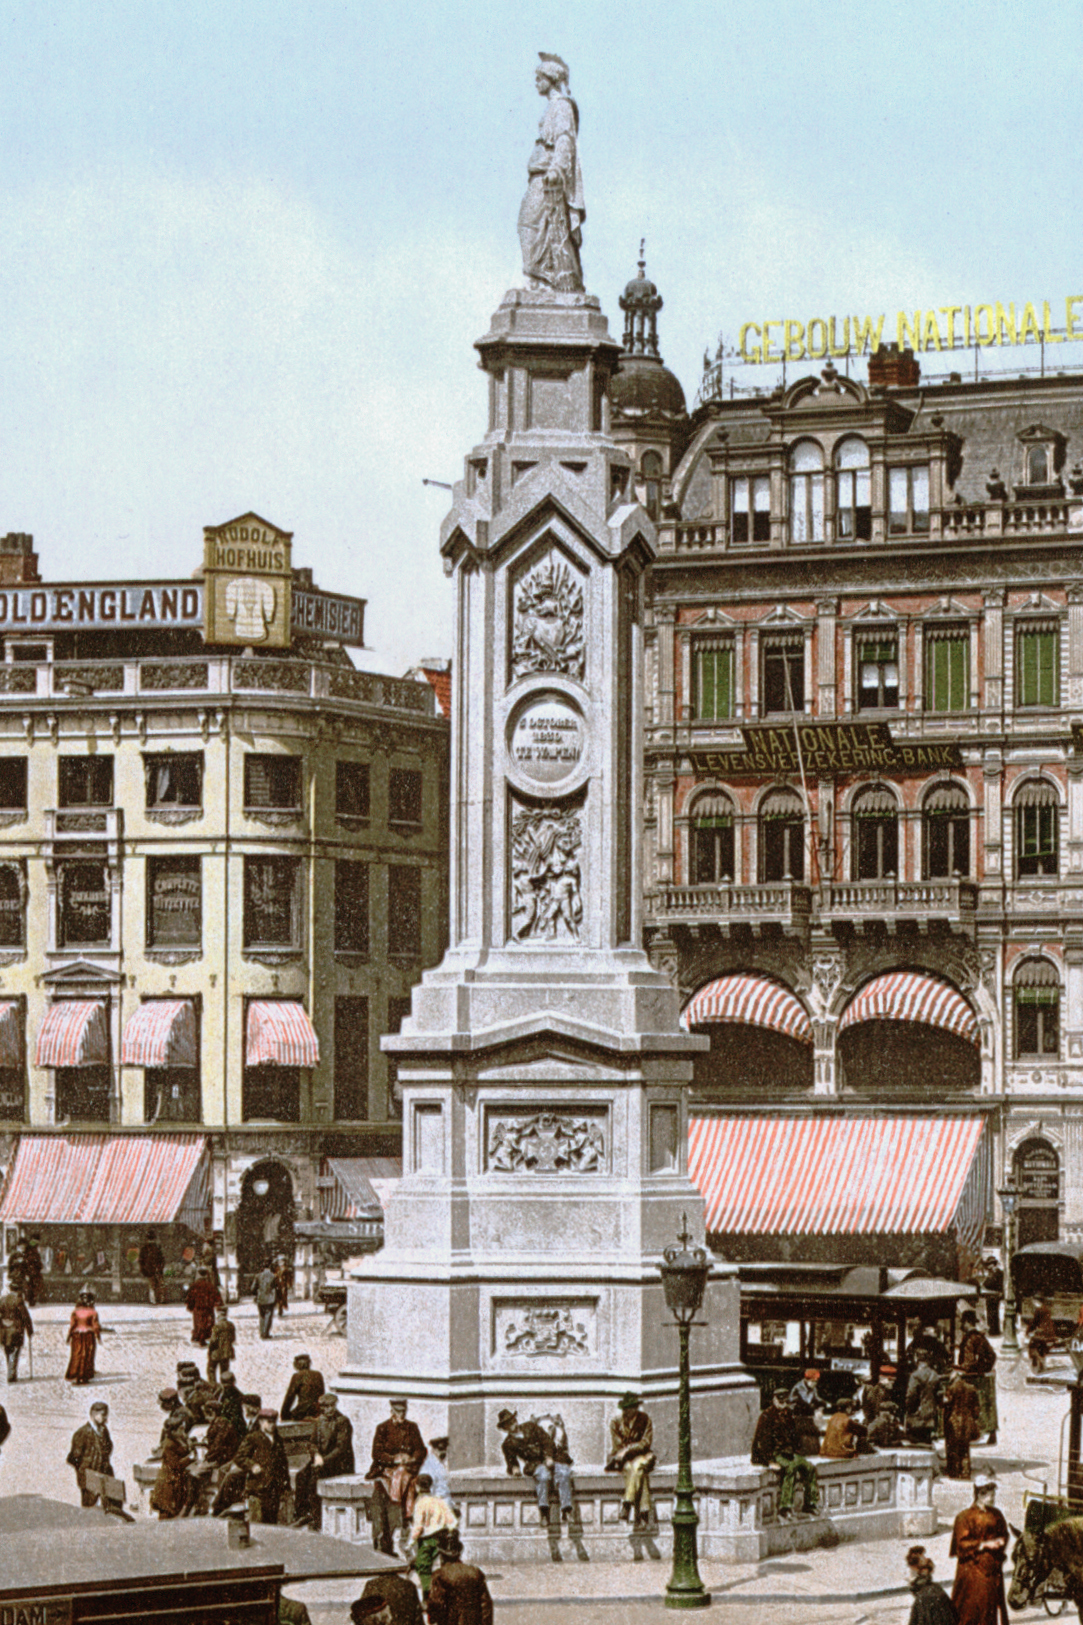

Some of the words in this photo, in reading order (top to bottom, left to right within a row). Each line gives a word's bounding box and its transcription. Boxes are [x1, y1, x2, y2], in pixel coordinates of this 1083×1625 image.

[738, 315, 886, 364] GEBOUW
[897, 295, 1083, 352] NATIONALE
[217, 526, 281, 547] RUDOLF
[216, 548, 284, 570] HOFHUIS
[52, 588, 199, 621] ENGLAND
[750, 724, 886, 753] NATONALE
